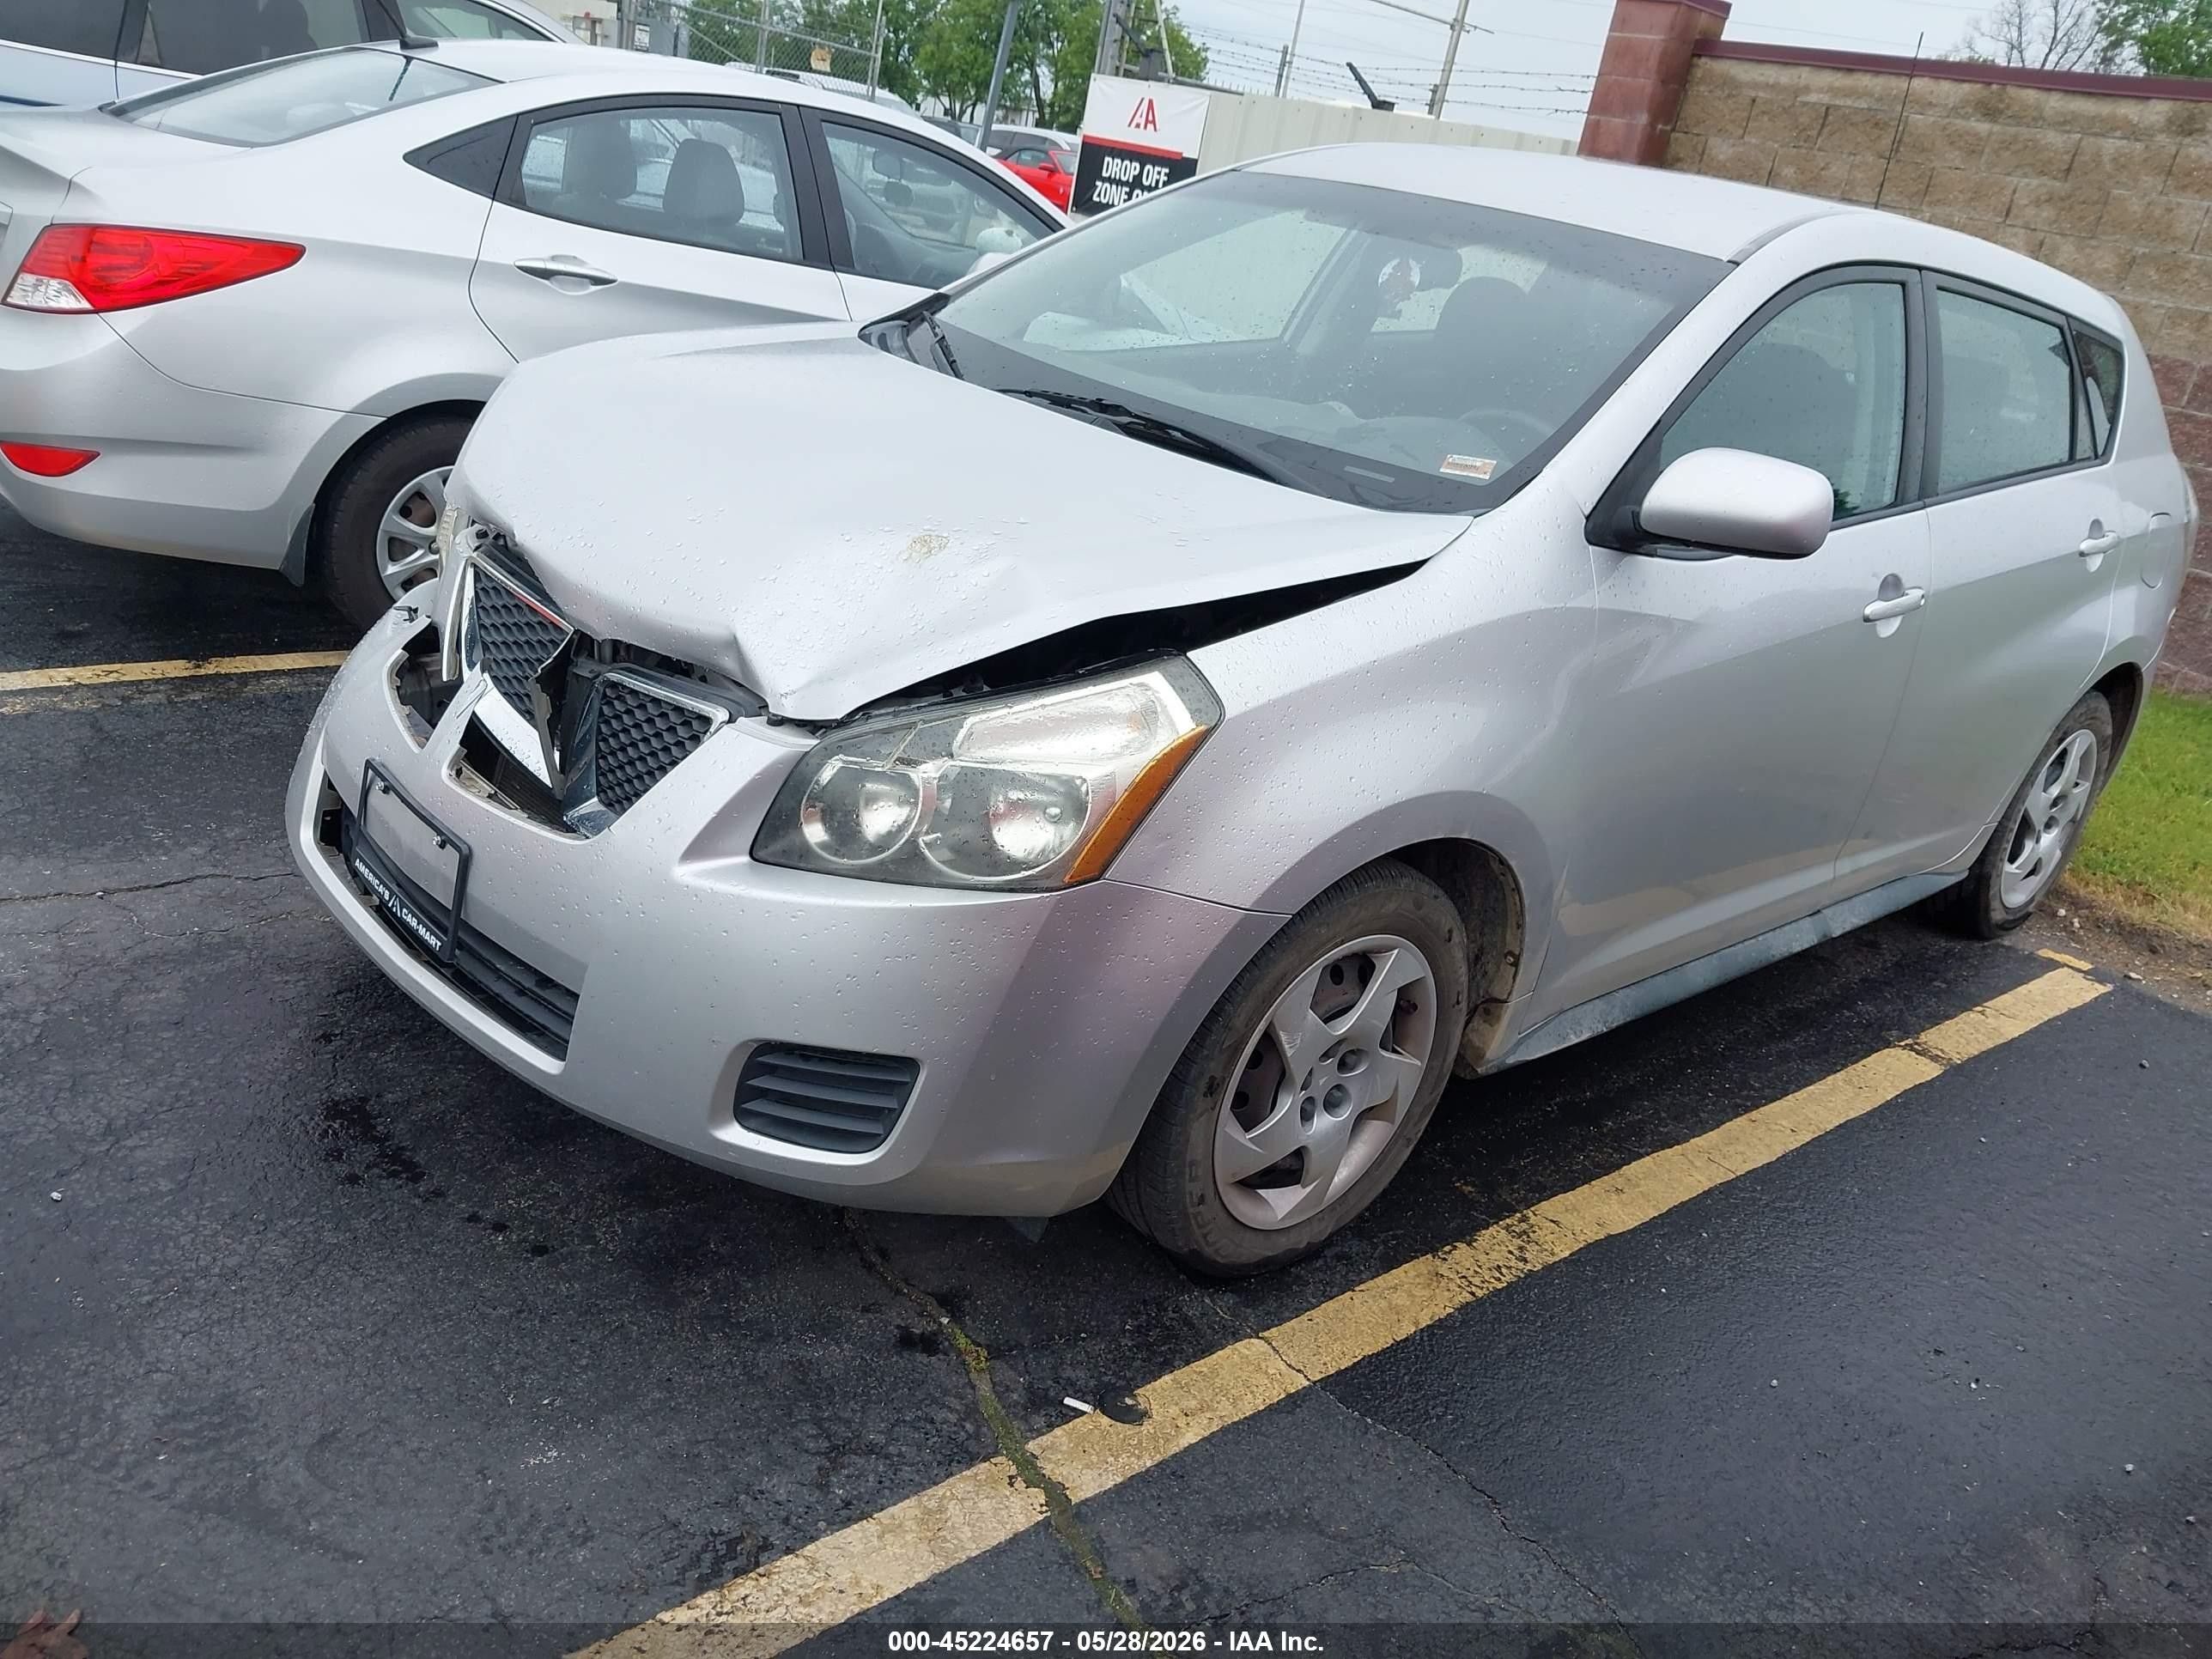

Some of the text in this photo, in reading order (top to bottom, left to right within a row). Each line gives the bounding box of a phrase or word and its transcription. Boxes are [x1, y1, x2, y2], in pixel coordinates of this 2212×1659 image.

[1102, 156, 1170, 188] DROP OFF
[1092, 180, 1130, 206] ZONE
[355, 858, 390, 902] AMERICA'S
